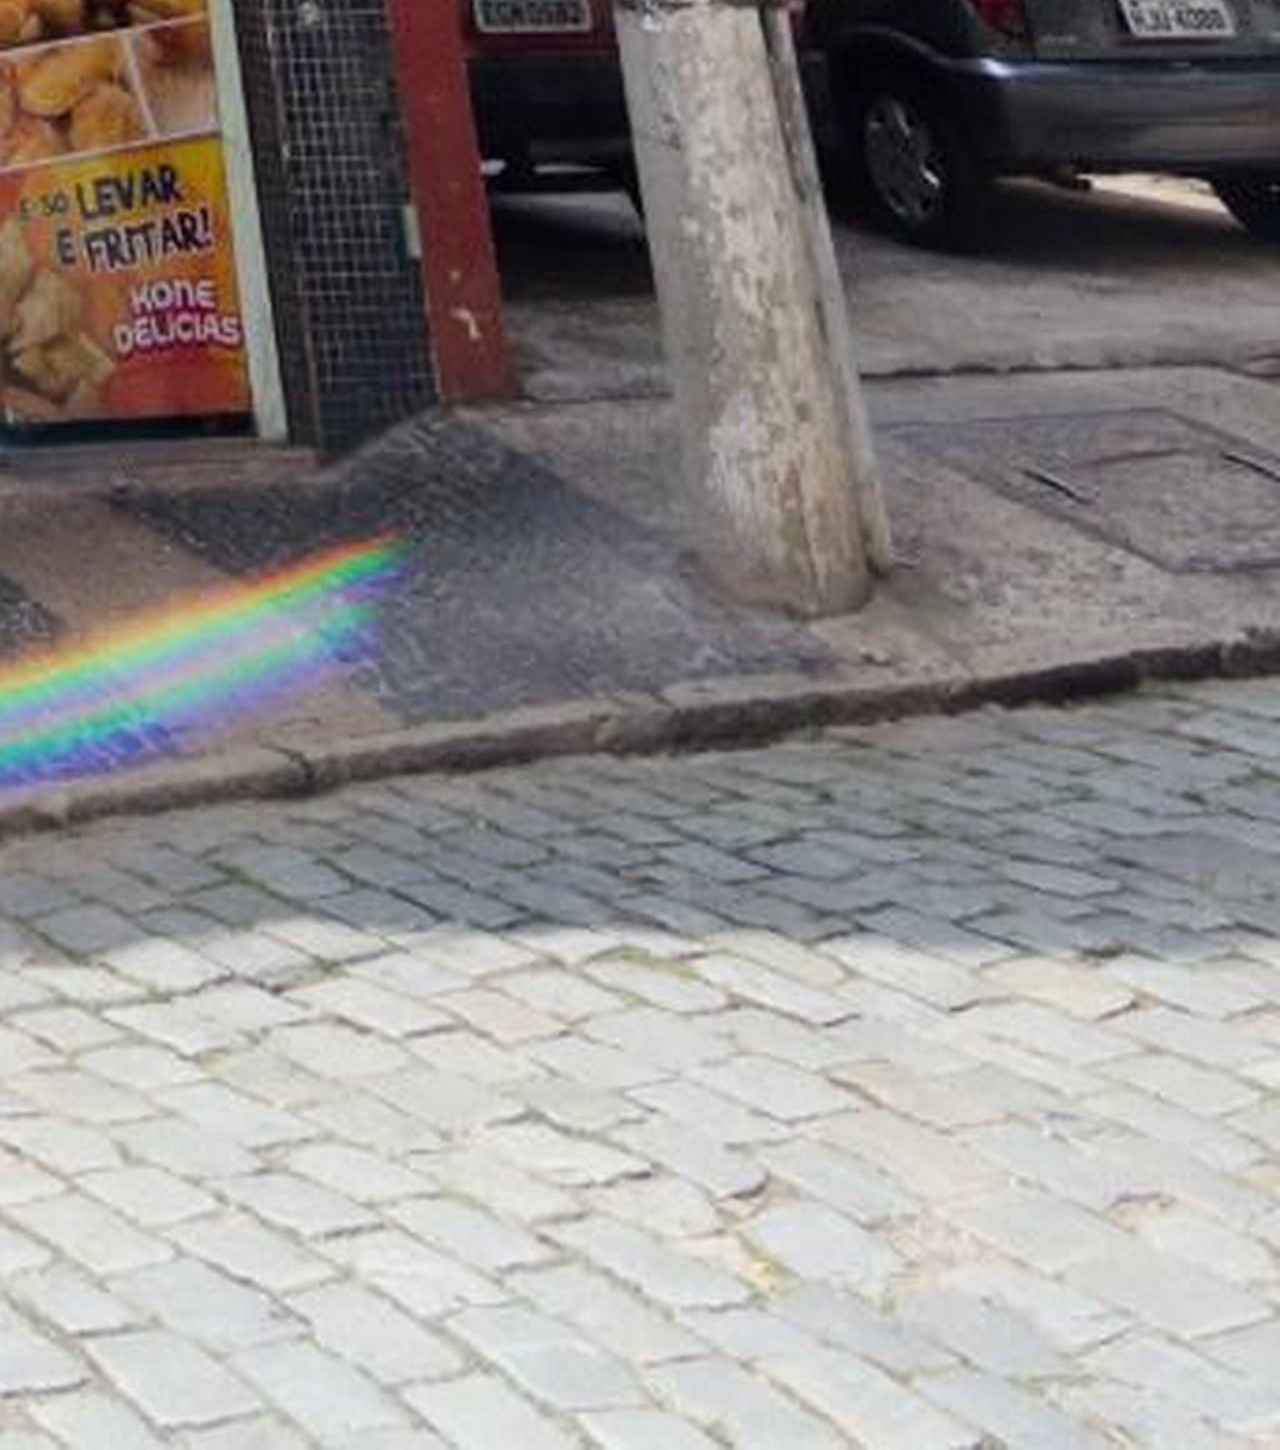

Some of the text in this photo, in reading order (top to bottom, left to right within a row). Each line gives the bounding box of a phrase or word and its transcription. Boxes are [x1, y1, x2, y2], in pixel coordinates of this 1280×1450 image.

[75, 165, 183, 219] LEVAR
[57, 208, 214, 273] E FRITAR!
[114, 316, 241, 355] DELICIAS
